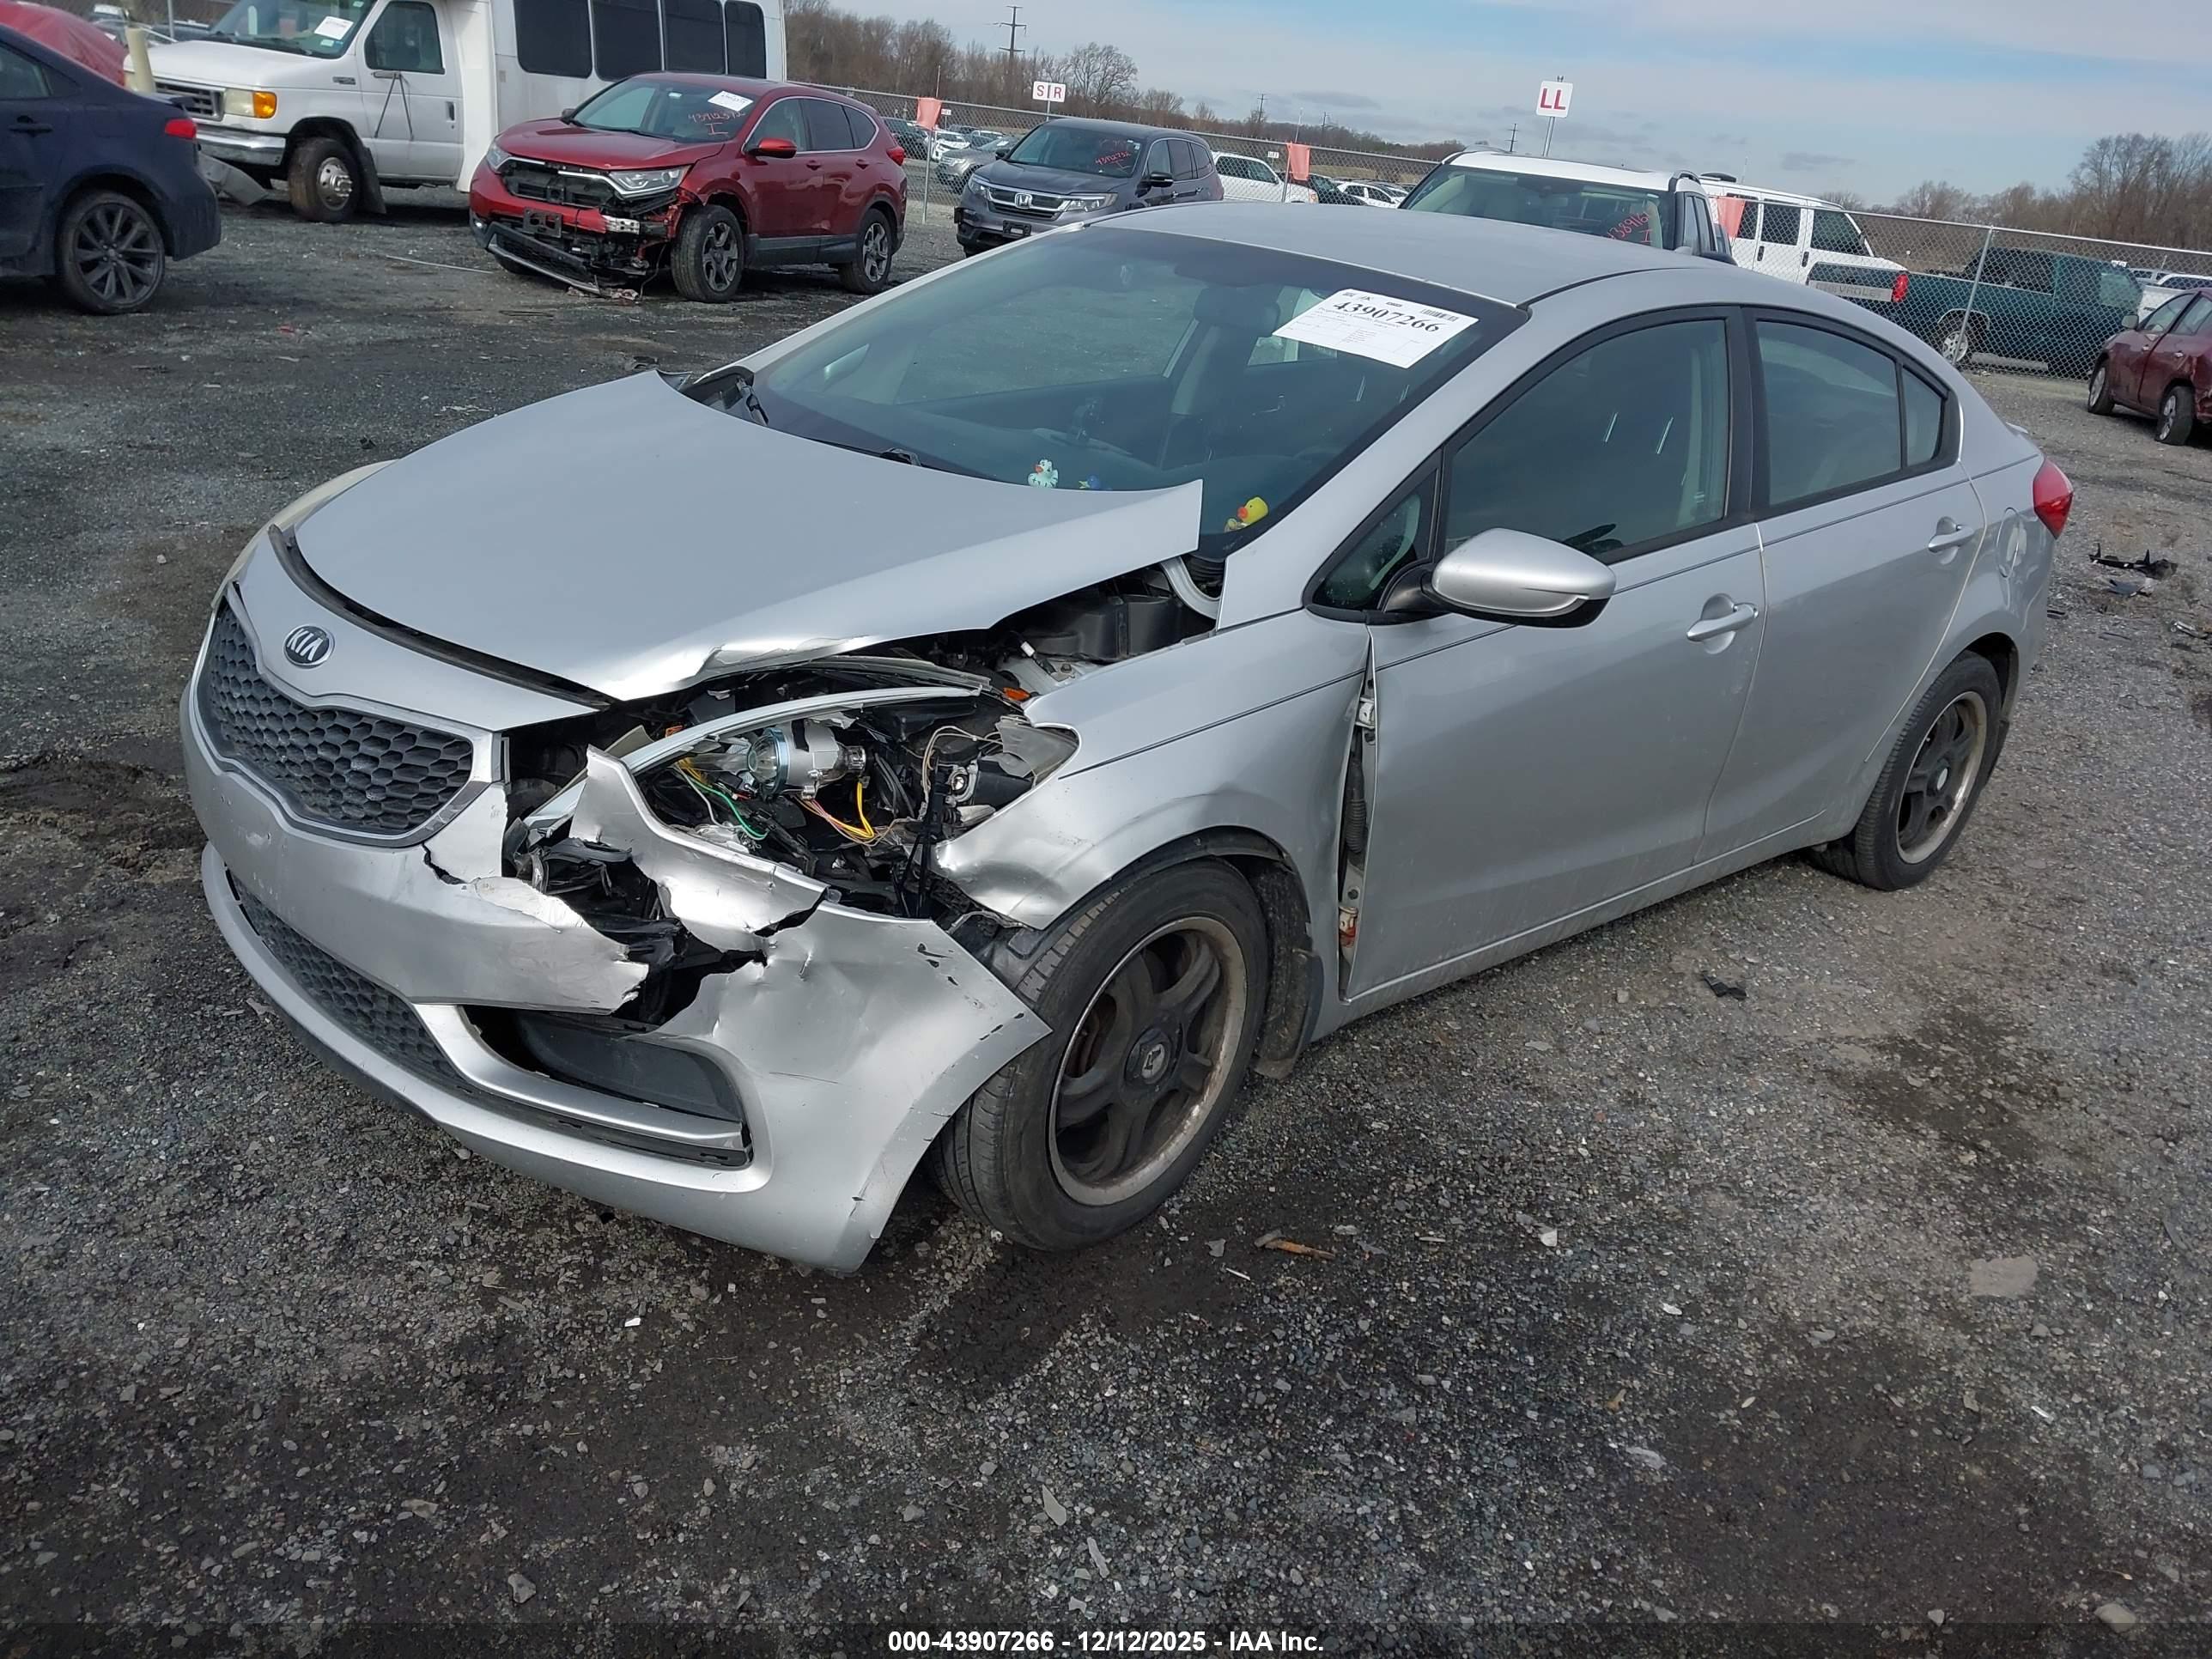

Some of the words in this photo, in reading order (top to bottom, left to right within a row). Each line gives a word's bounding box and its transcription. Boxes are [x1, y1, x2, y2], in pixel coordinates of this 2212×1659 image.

[1540, 88, 1566, 110] LL
[1333, 302, 1446, 332] 43907266
[286, 628, 324, 661] KIA
